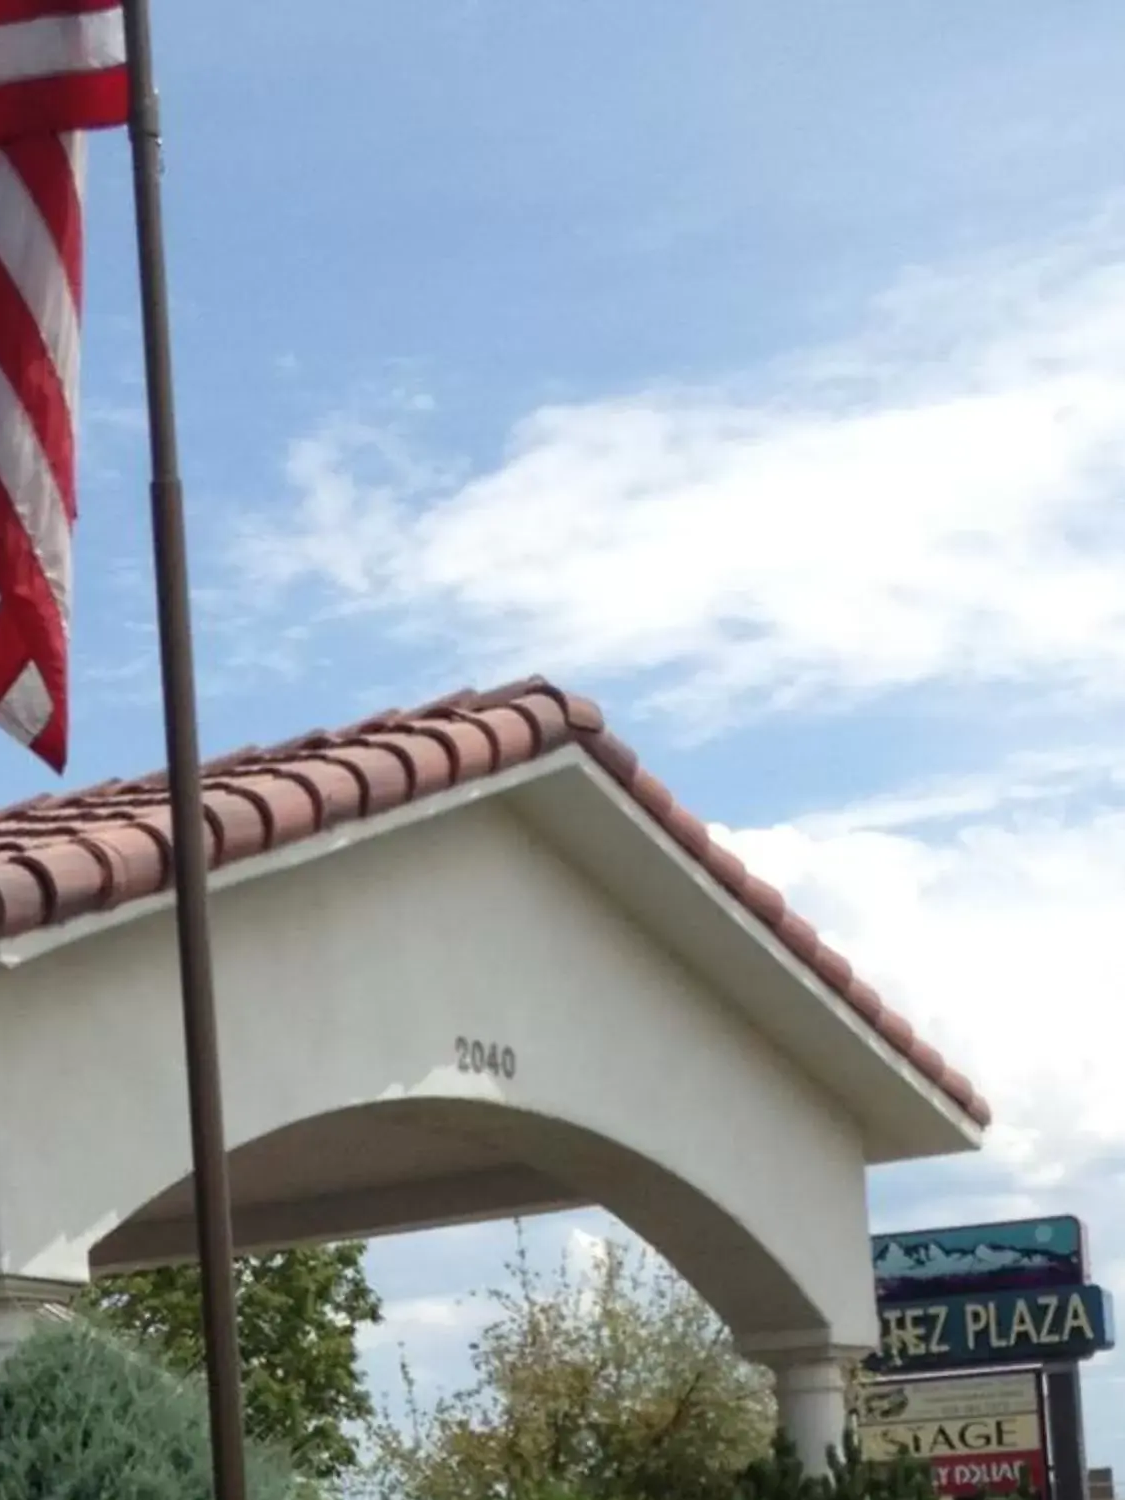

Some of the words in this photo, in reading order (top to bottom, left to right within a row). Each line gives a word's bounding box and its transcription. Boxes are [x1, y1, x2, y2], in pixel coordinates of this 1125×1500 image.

[455, 1036, 516, 1080] 2040
[964, 1293, 1094, 1350] PLAZA
[880, 1420, 1018, 1456] STAGE
